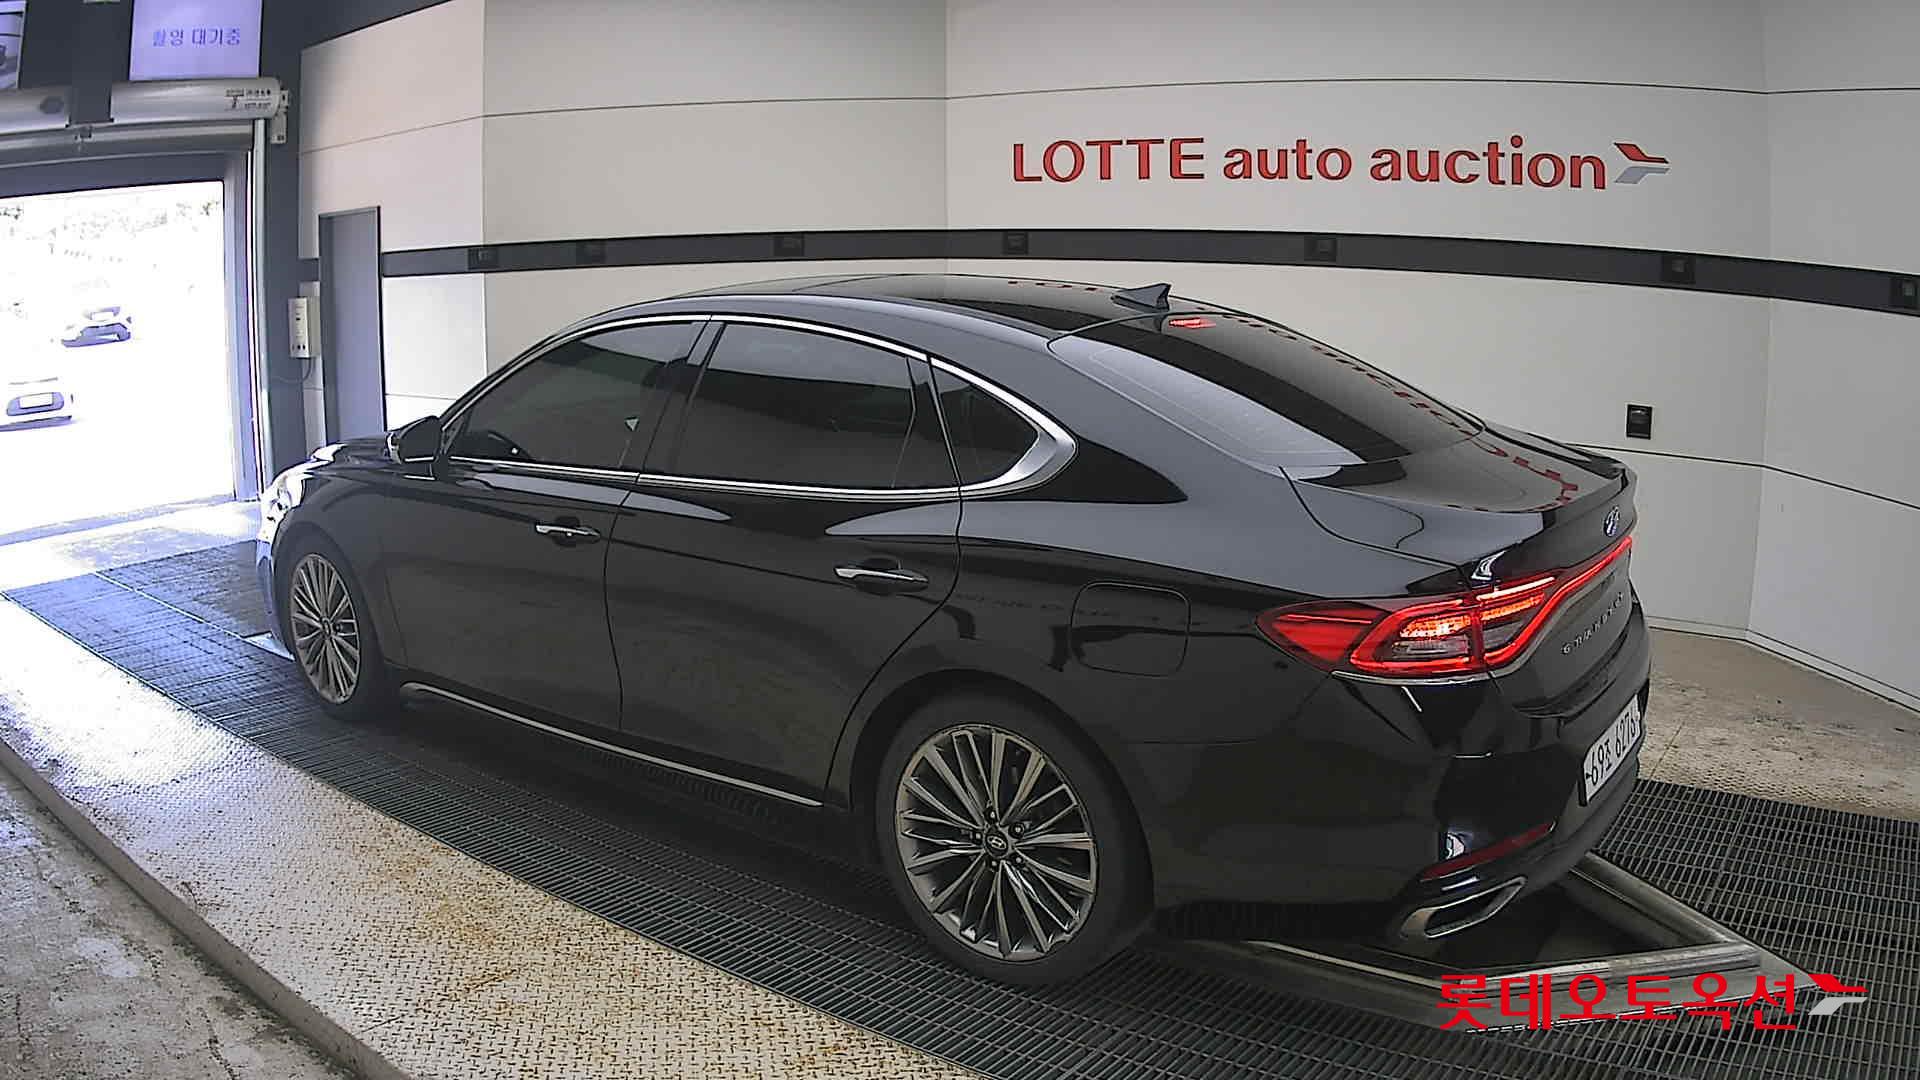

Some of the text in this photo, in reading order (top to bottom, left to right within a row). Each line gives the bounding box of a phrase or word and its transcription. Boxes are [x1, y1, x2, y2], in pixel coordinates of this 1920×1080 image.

[191, 28, 241, 46] 대기중
[1013, 136, 1607, 190] LOTTE auto auction
